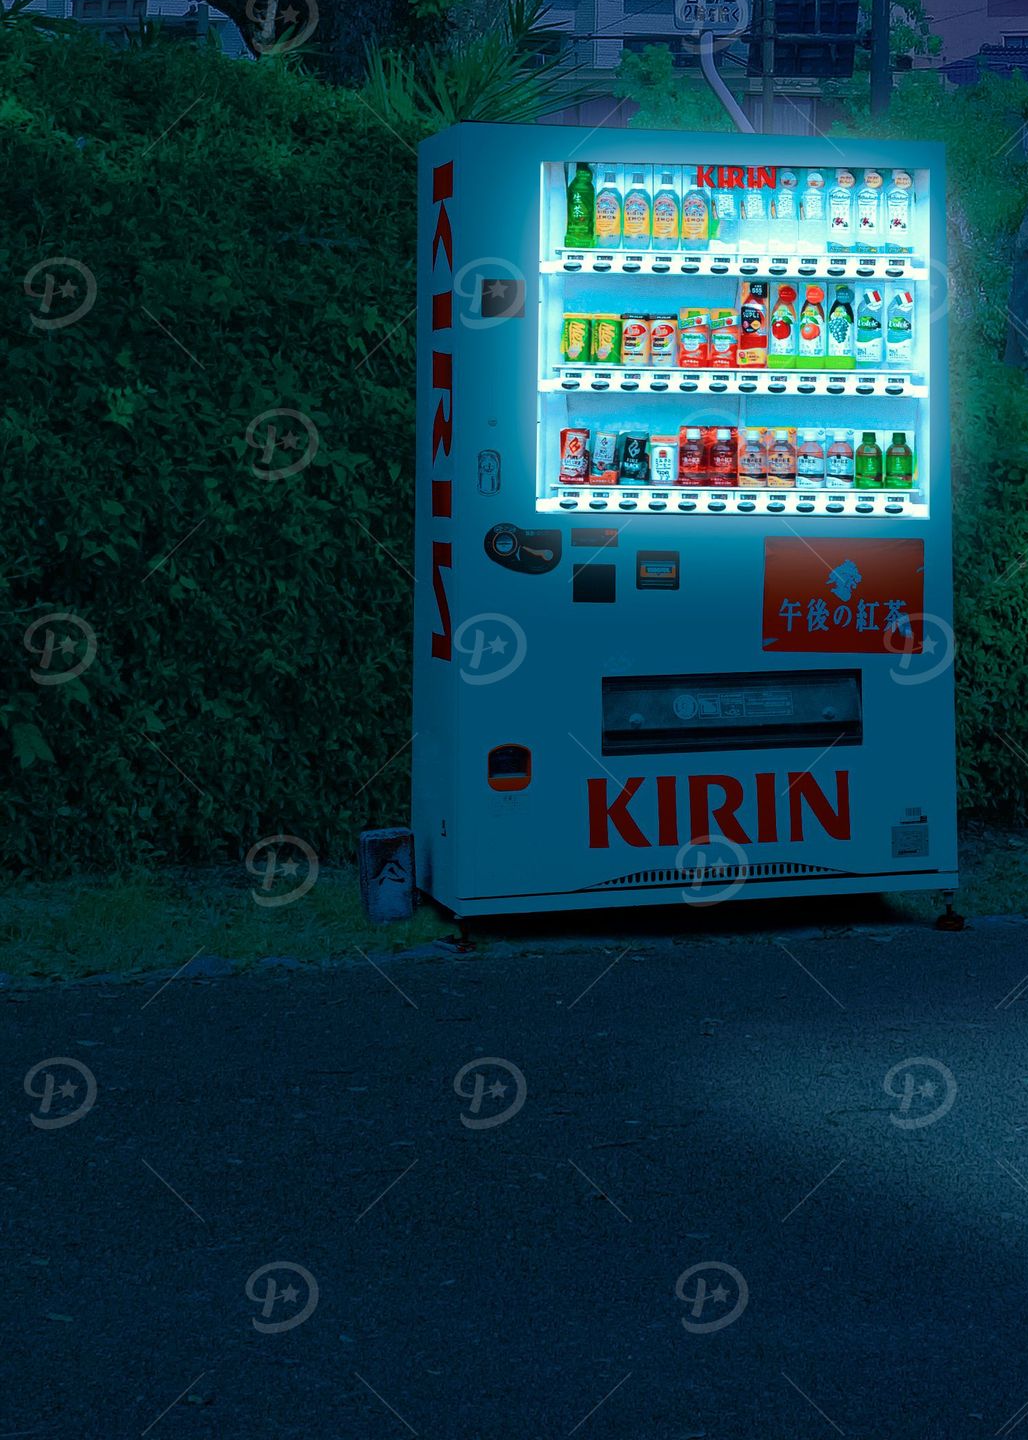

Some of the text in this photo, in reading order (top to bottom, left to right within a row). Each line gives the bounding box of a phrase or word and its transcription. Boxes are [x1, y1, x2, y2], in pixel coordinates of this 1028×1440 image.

[697, 166, 777, 189] KIRIN
[778, 598, 912, 636] 午後の紅茶
[587, 770, 852, 850] KIRIN
